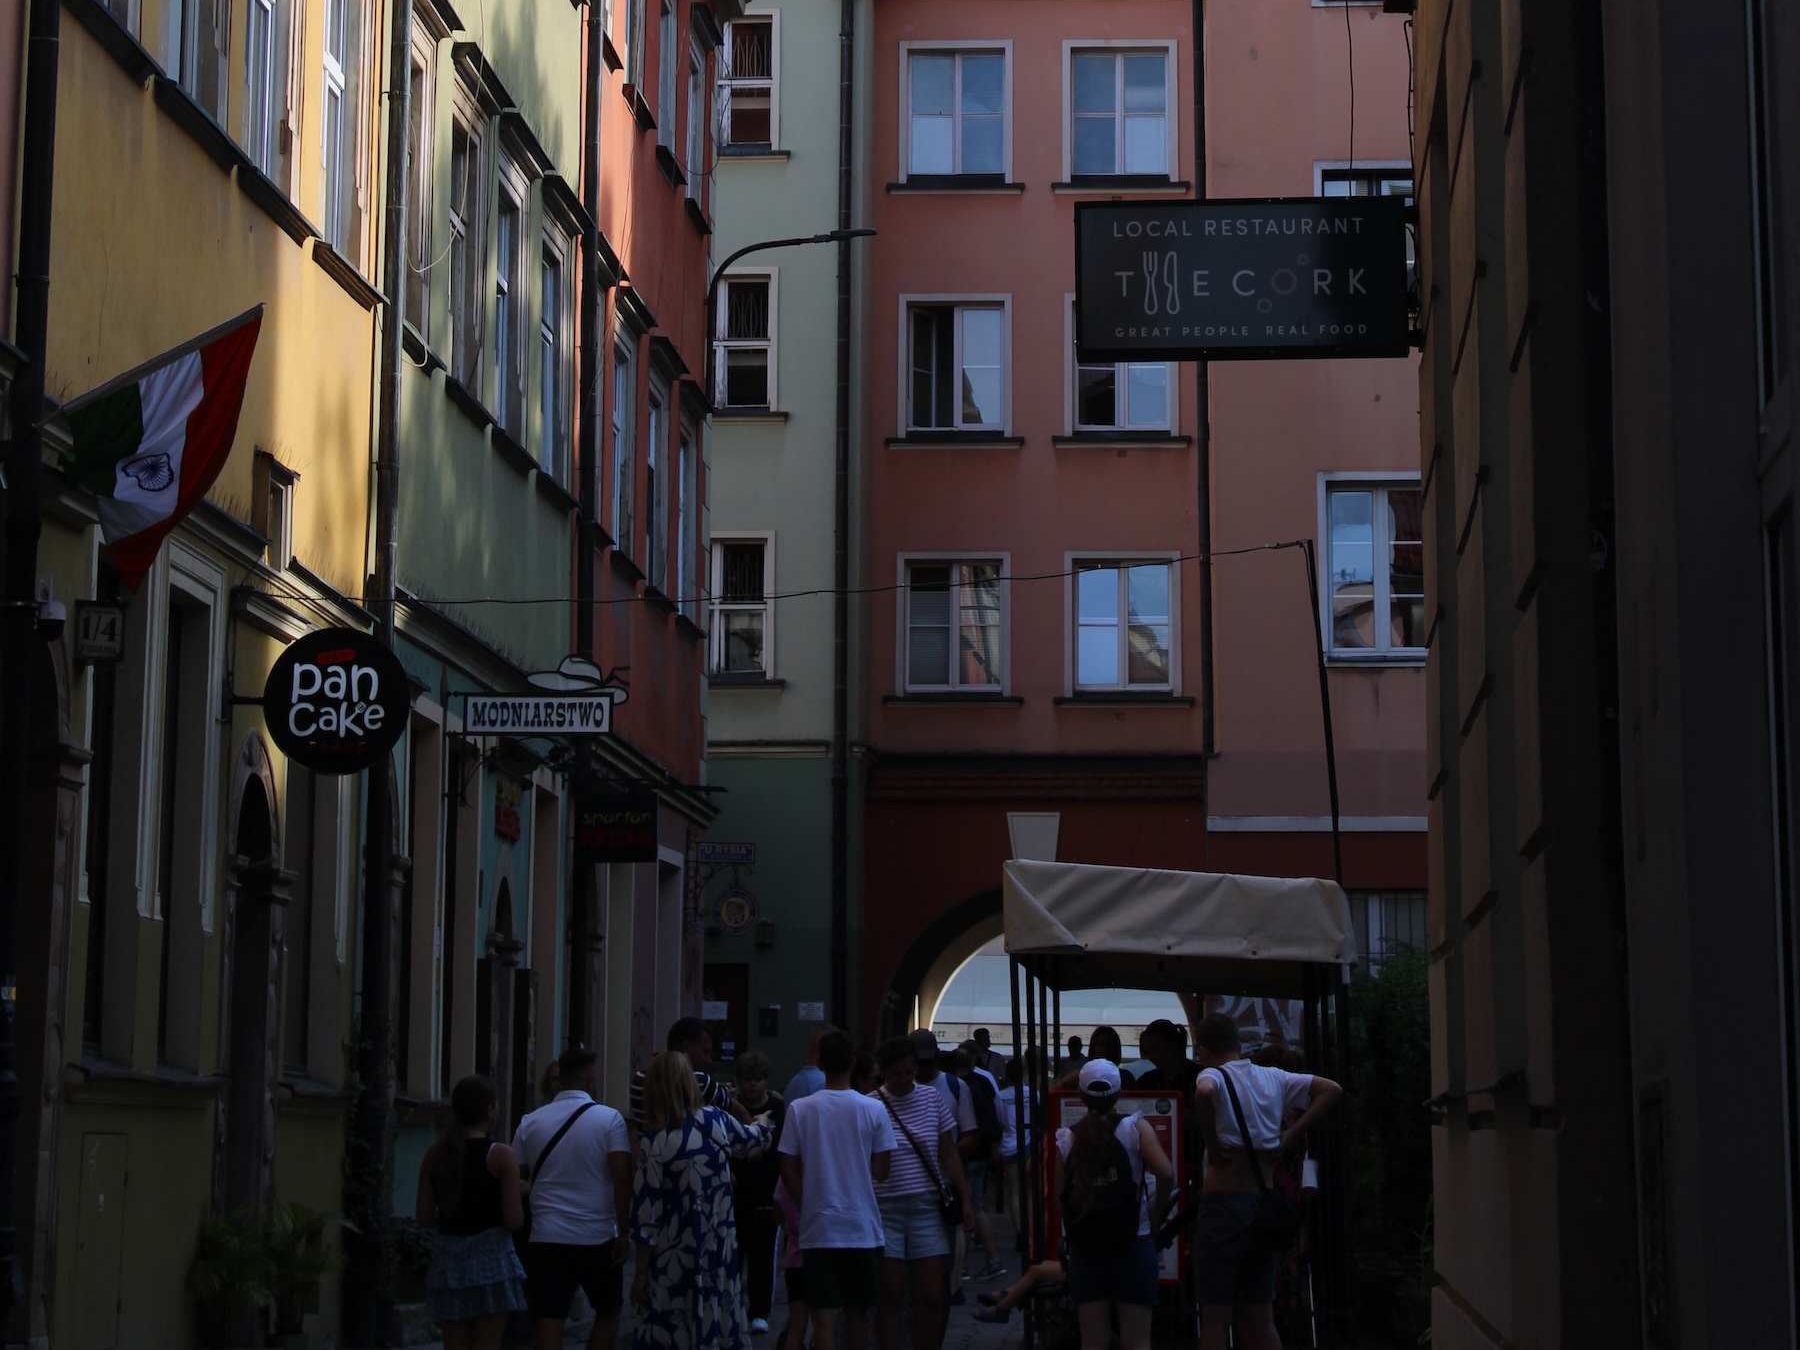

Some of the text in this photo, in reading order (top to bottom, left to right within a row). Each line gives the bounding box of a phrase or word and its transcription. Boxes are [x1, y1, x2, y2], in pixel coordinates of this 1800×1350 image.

[1113, 217, 1364, 237] LOCAL RESTAURANT
[1232, 267, 1367, 297] CORK
[1115, 323, 1367, 338] GREAT PEOPLE REAL FOOD
[81, 614, 117, 642] 1/4
[290, 661, 380, 704] pan
[472, 701, 605, 728] MODNIARSTWO
[580, 828, 654, 847] KEBAB
